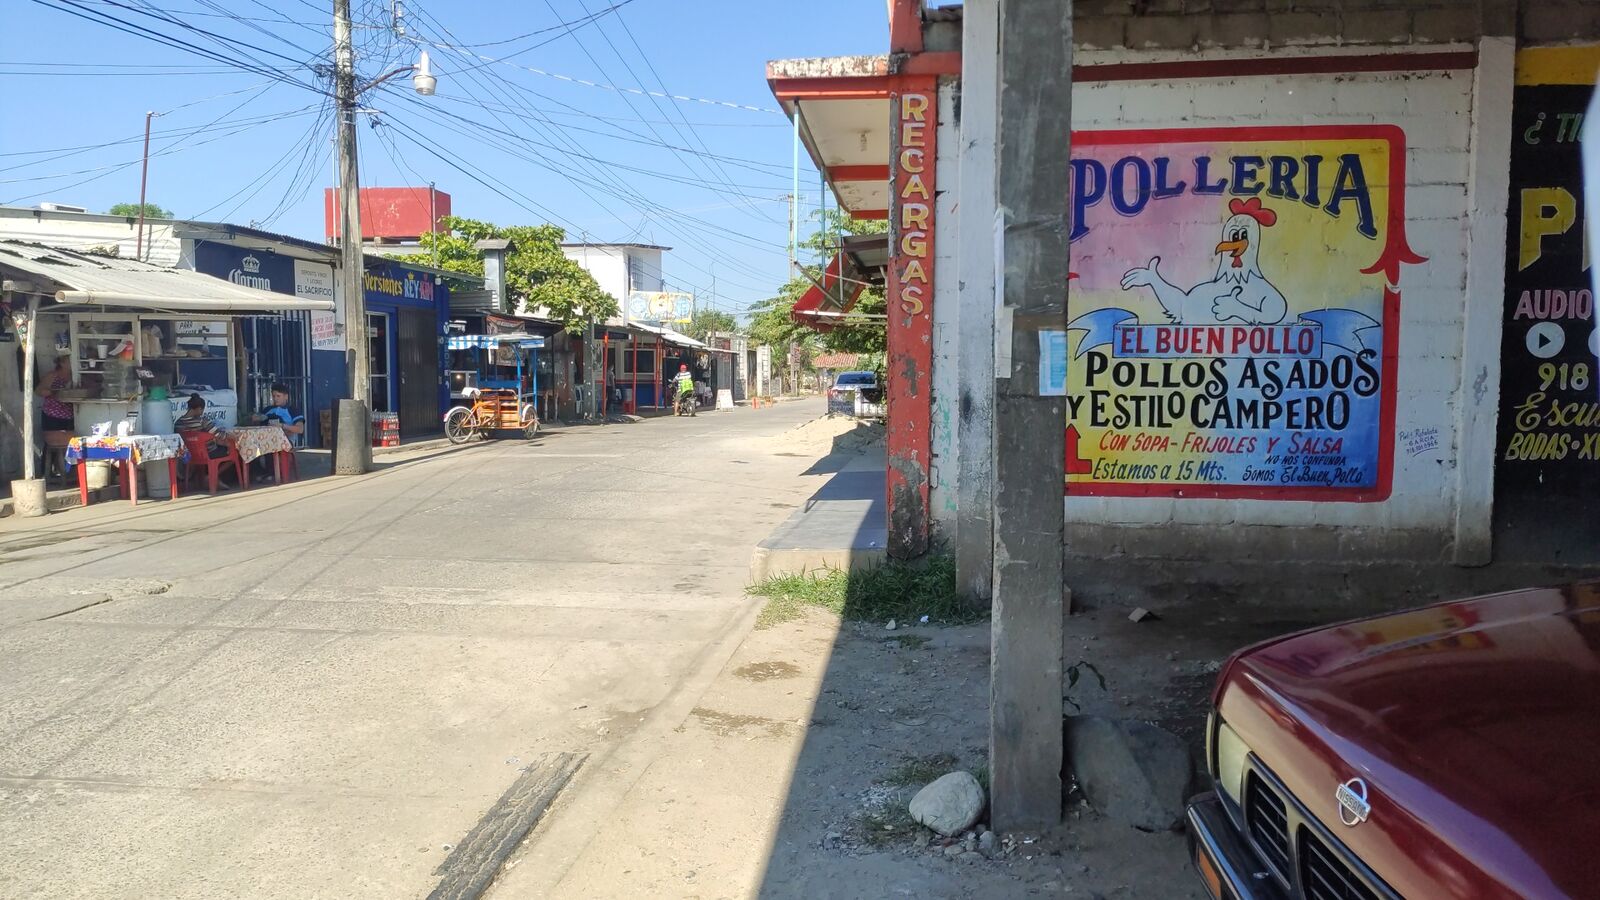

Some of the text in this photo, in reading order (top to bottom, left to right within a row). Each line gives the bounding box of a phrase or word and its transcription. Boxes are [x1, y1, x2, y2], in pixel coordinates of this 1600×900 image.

[901, 94, 928, 314] RECARGAS
[1070, 153, 1378, 244] POLLERIA
[228, 268, 271, 291] Corona
[297, 284, 332, 296] EL SACRIFICIO
[404, 278, 419, 299] REY
[1513, 289, 1593, 320] AUDIO
[1156, 327, 1225, 354] BUEN
[1085, 351, 1229, 399] POLLOS
[1237, 348, 1380, 401] ASADOS
[1538, 362, 1589, 391] 918
[1066, 390, 1350, 430] Y ESTILO CAMPERO
[1100, 430, 1131, 451] CON
[1181, 432, 1258, 454] FRIJOLES
[1267, 437, 1280, 454] Y
[1288, 431, 1343, 454] SALSA
[1093, 458, 1227, 481] Estamos a 15 Mts.
[1265, 454, 1346, 466] NO NOS CONFUNDA
[1338, 787, 1367, 817] NISSAN
